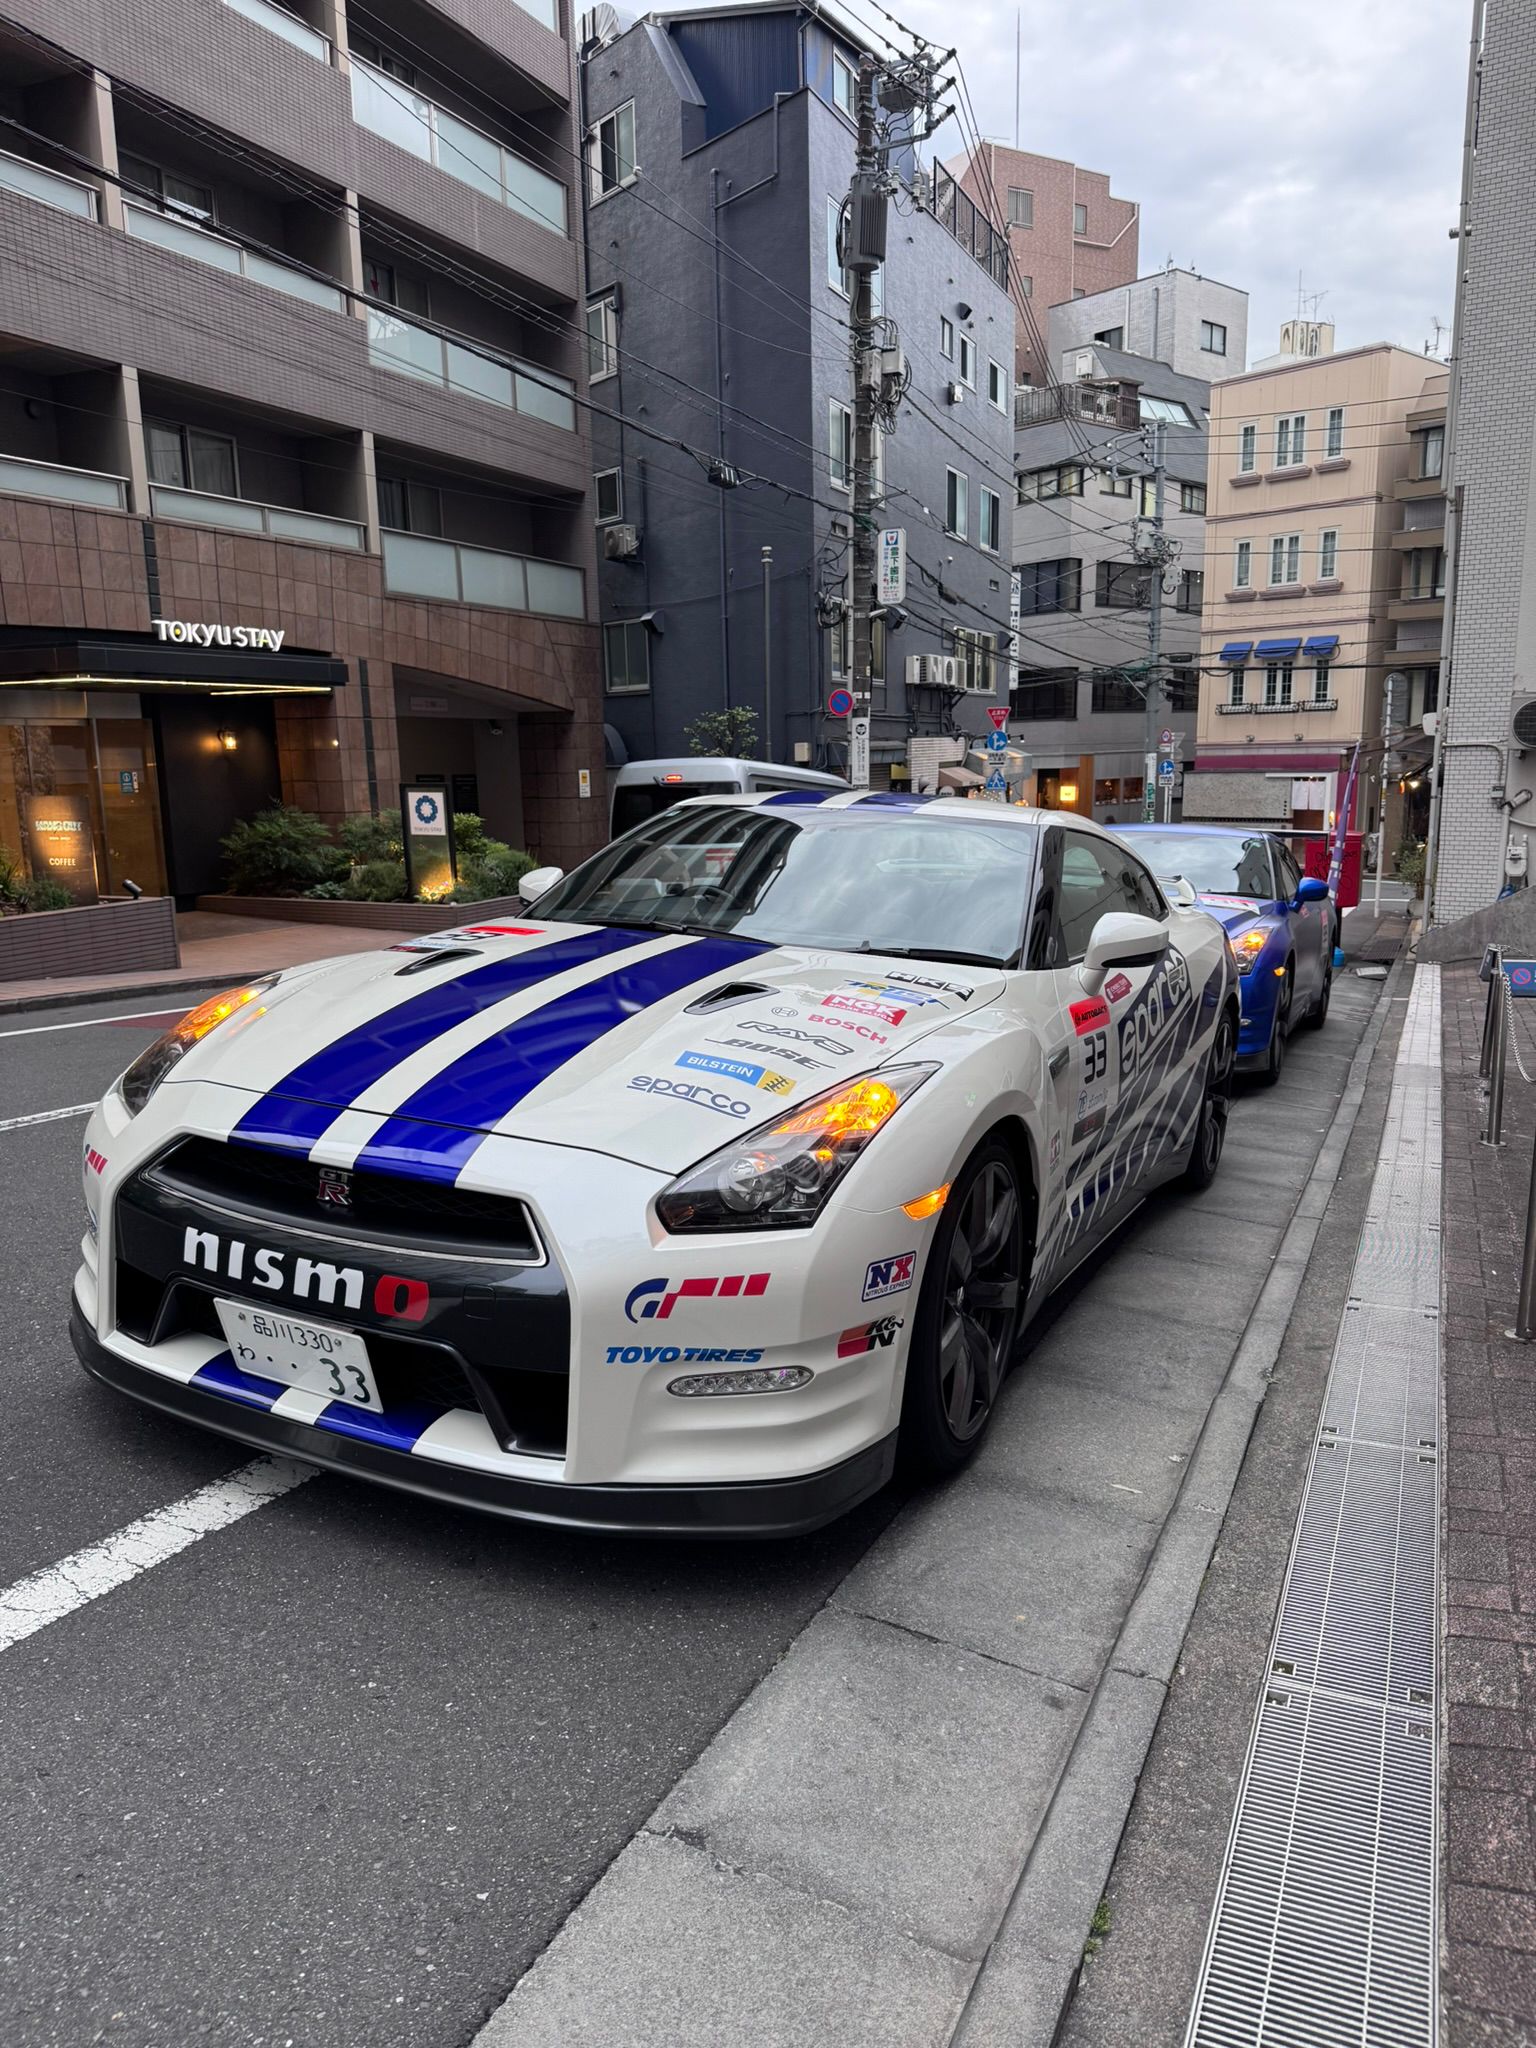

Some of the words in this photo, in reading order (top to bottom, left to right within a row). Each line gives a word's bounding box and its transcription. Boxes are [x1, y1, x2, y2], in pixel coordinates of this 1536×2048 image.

[151, 619, 231, 647] TOKYU
[232, 625, 285, 652] STAY
[49, 857, 77, 867] COFFEE
[885, 971, 975, 1002] HKS
[831, 995, 899, 1018] NGK
[1081, 1004, 1107, 1021] AUTOBACS
[737, 1021, 855, 1055] RAYS
[808, 1014, 888, 1045] BOSCH
[687, 1056, 754, 1078] BILSTEIN
[705, 1038, 836, 1070] BOSE
[1083, 1030, 1106, 1085] 33
[631, 1075, 751, 1115] sparco
[183, 1226, 430, 1321] nismo
[868, 1254, 914, 1290] NX
[865, 1286, 889, 1298] NITROUS
[889, 1279, 912, 1291] EXPRESS
[606, 1346, 681, 1364] TOYO
[684, 1347, 766, 1363] TIRES
